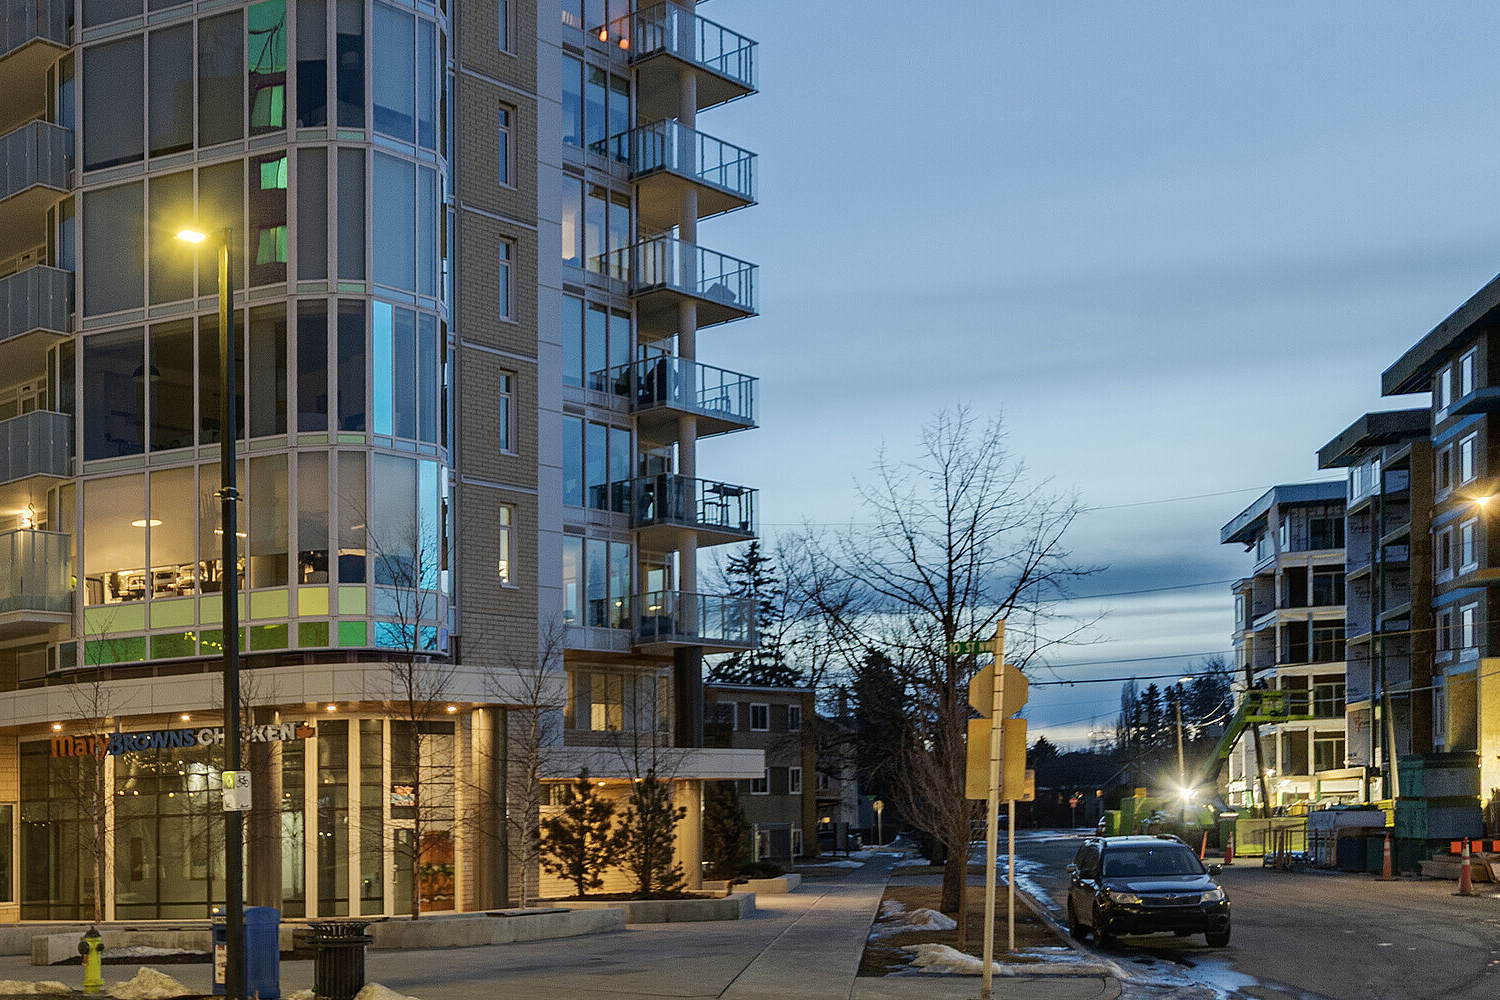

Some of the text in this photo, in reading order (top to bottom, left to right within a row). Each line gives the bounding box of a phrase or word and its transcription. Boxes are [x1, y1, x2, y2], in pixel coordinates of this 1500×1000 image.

[948, 643, 961, 654] 10
[965, 642, 976, 653] ST
[197, 722, 296, 746] CHKEN
